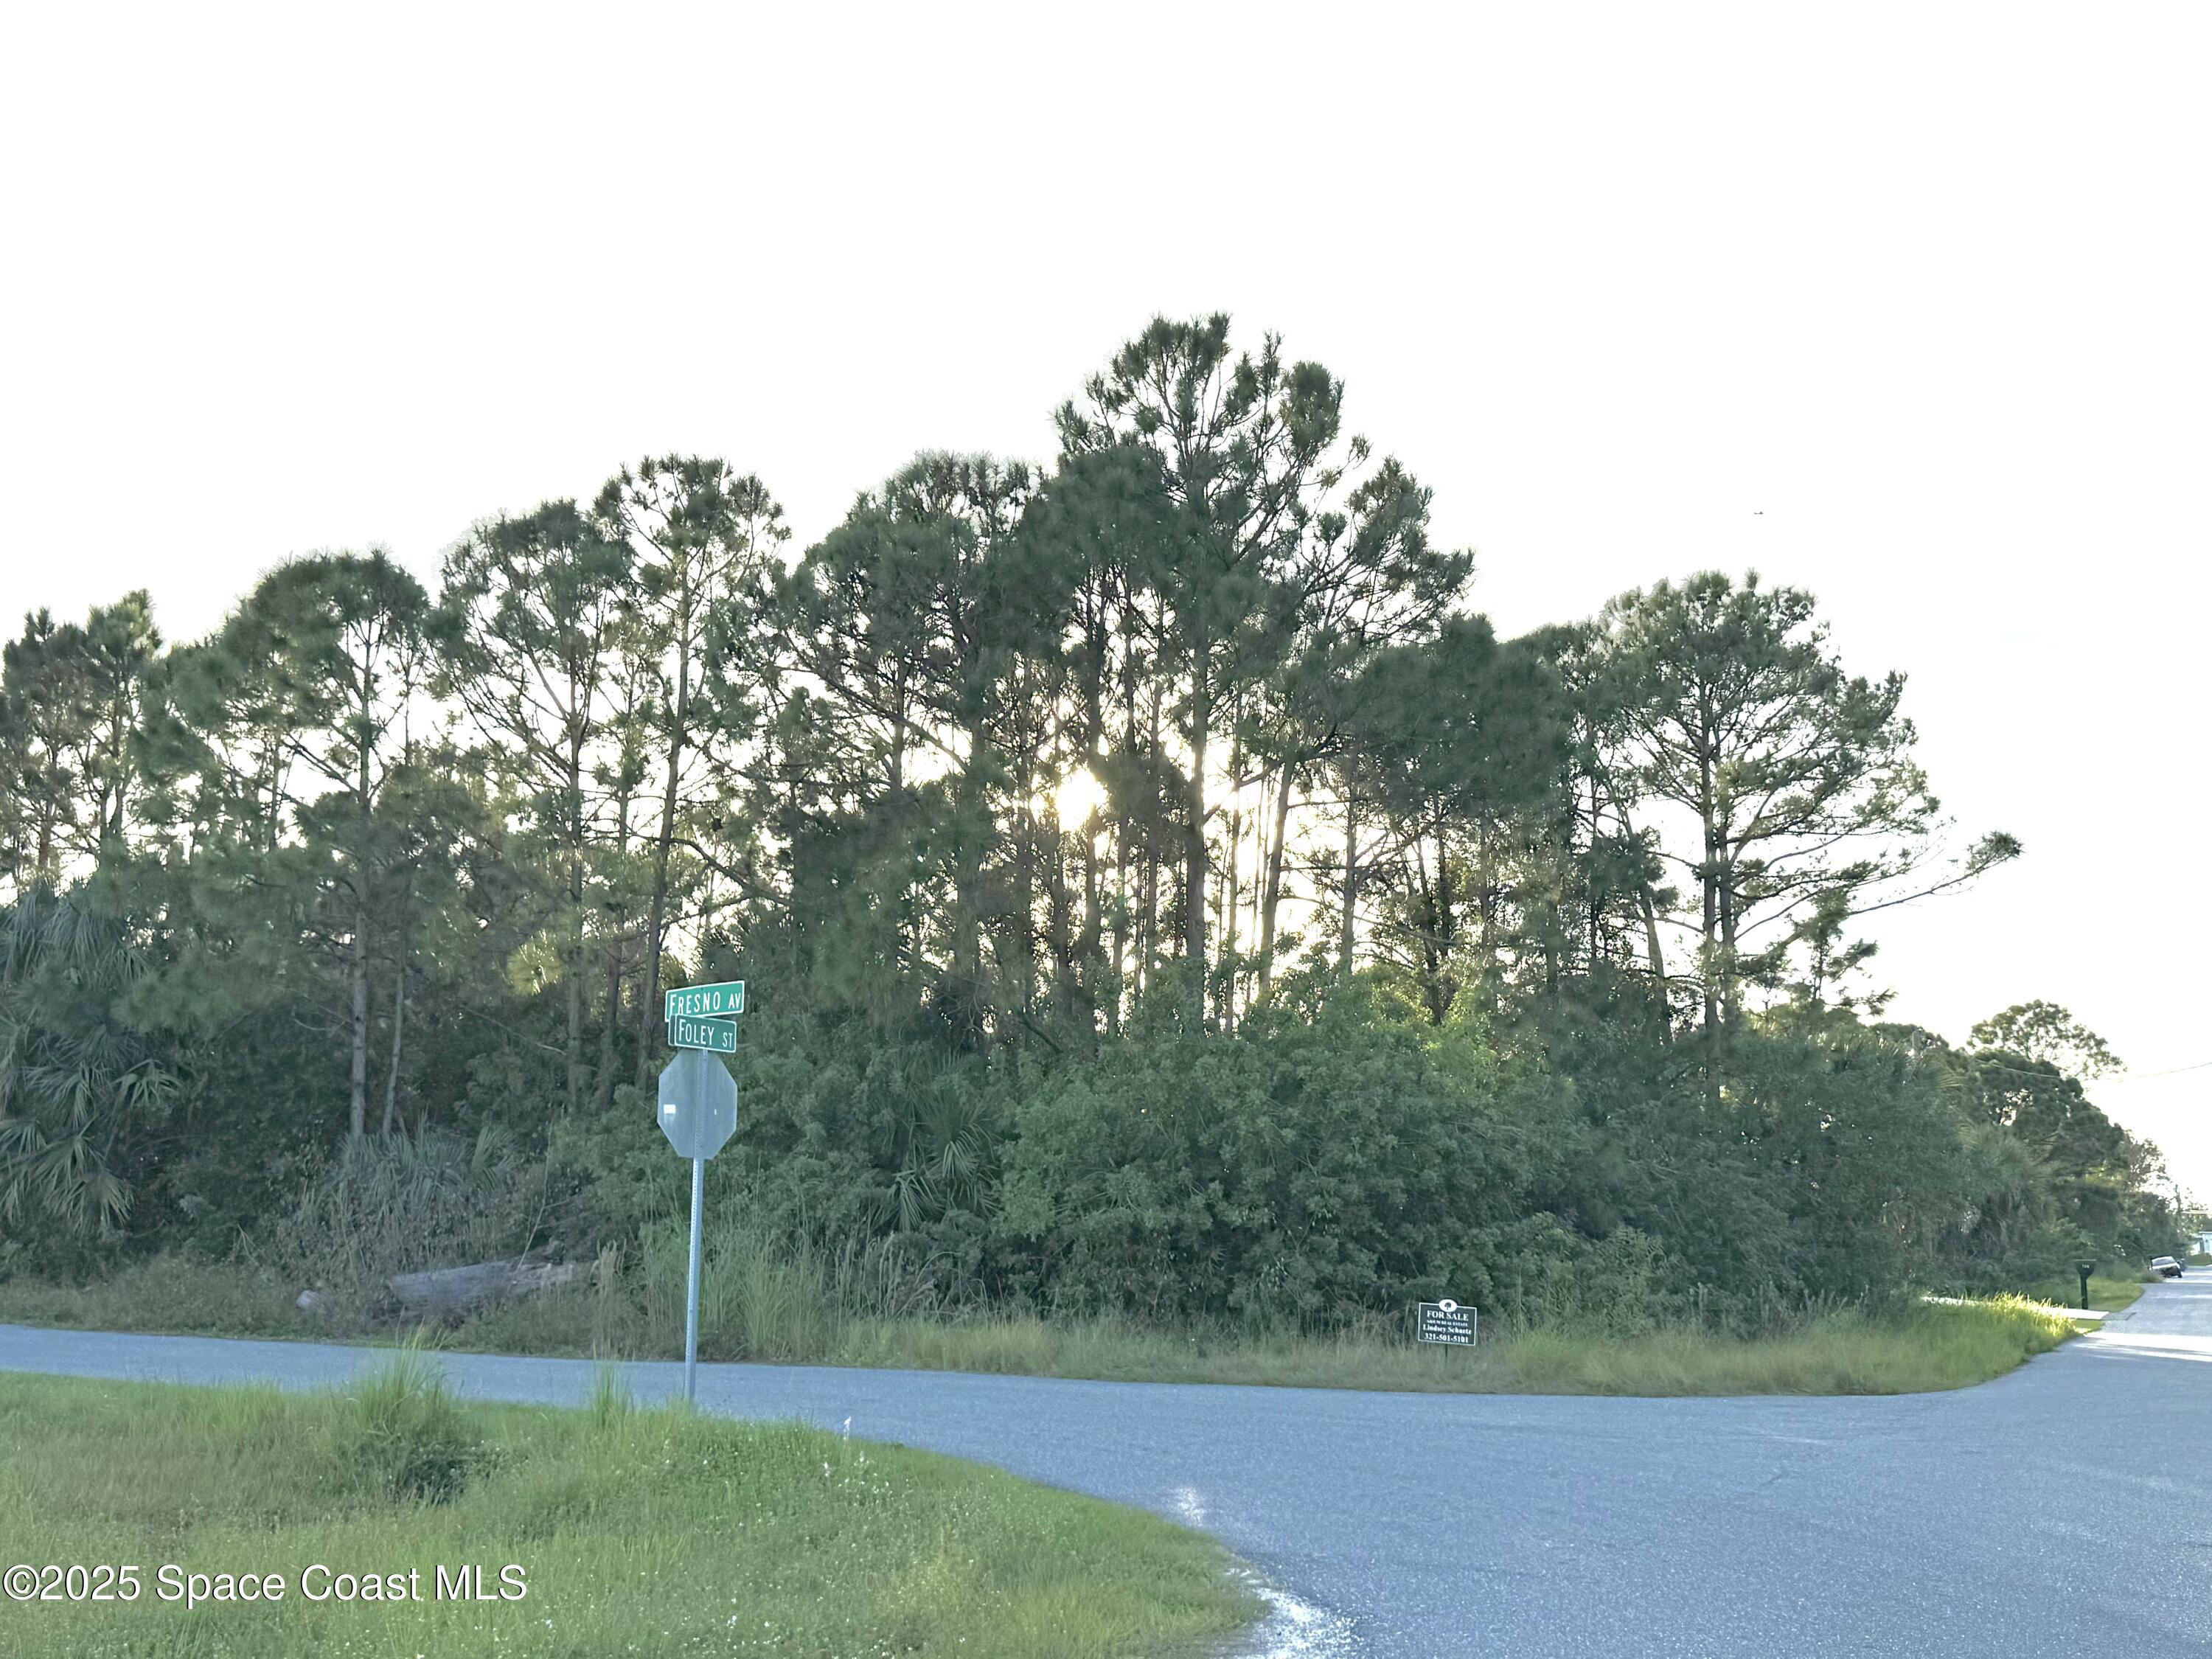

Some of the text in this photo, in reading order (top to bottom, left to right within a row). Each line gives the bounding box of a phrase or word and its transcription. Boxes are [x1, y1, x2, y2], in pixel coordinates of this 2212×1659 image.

[670, 991, 741, 1015] FRESNO AV
[678, 1019, 733, 1048] FOLEY ST
[1427, 1310, 1469, 1321] FOR SALE
